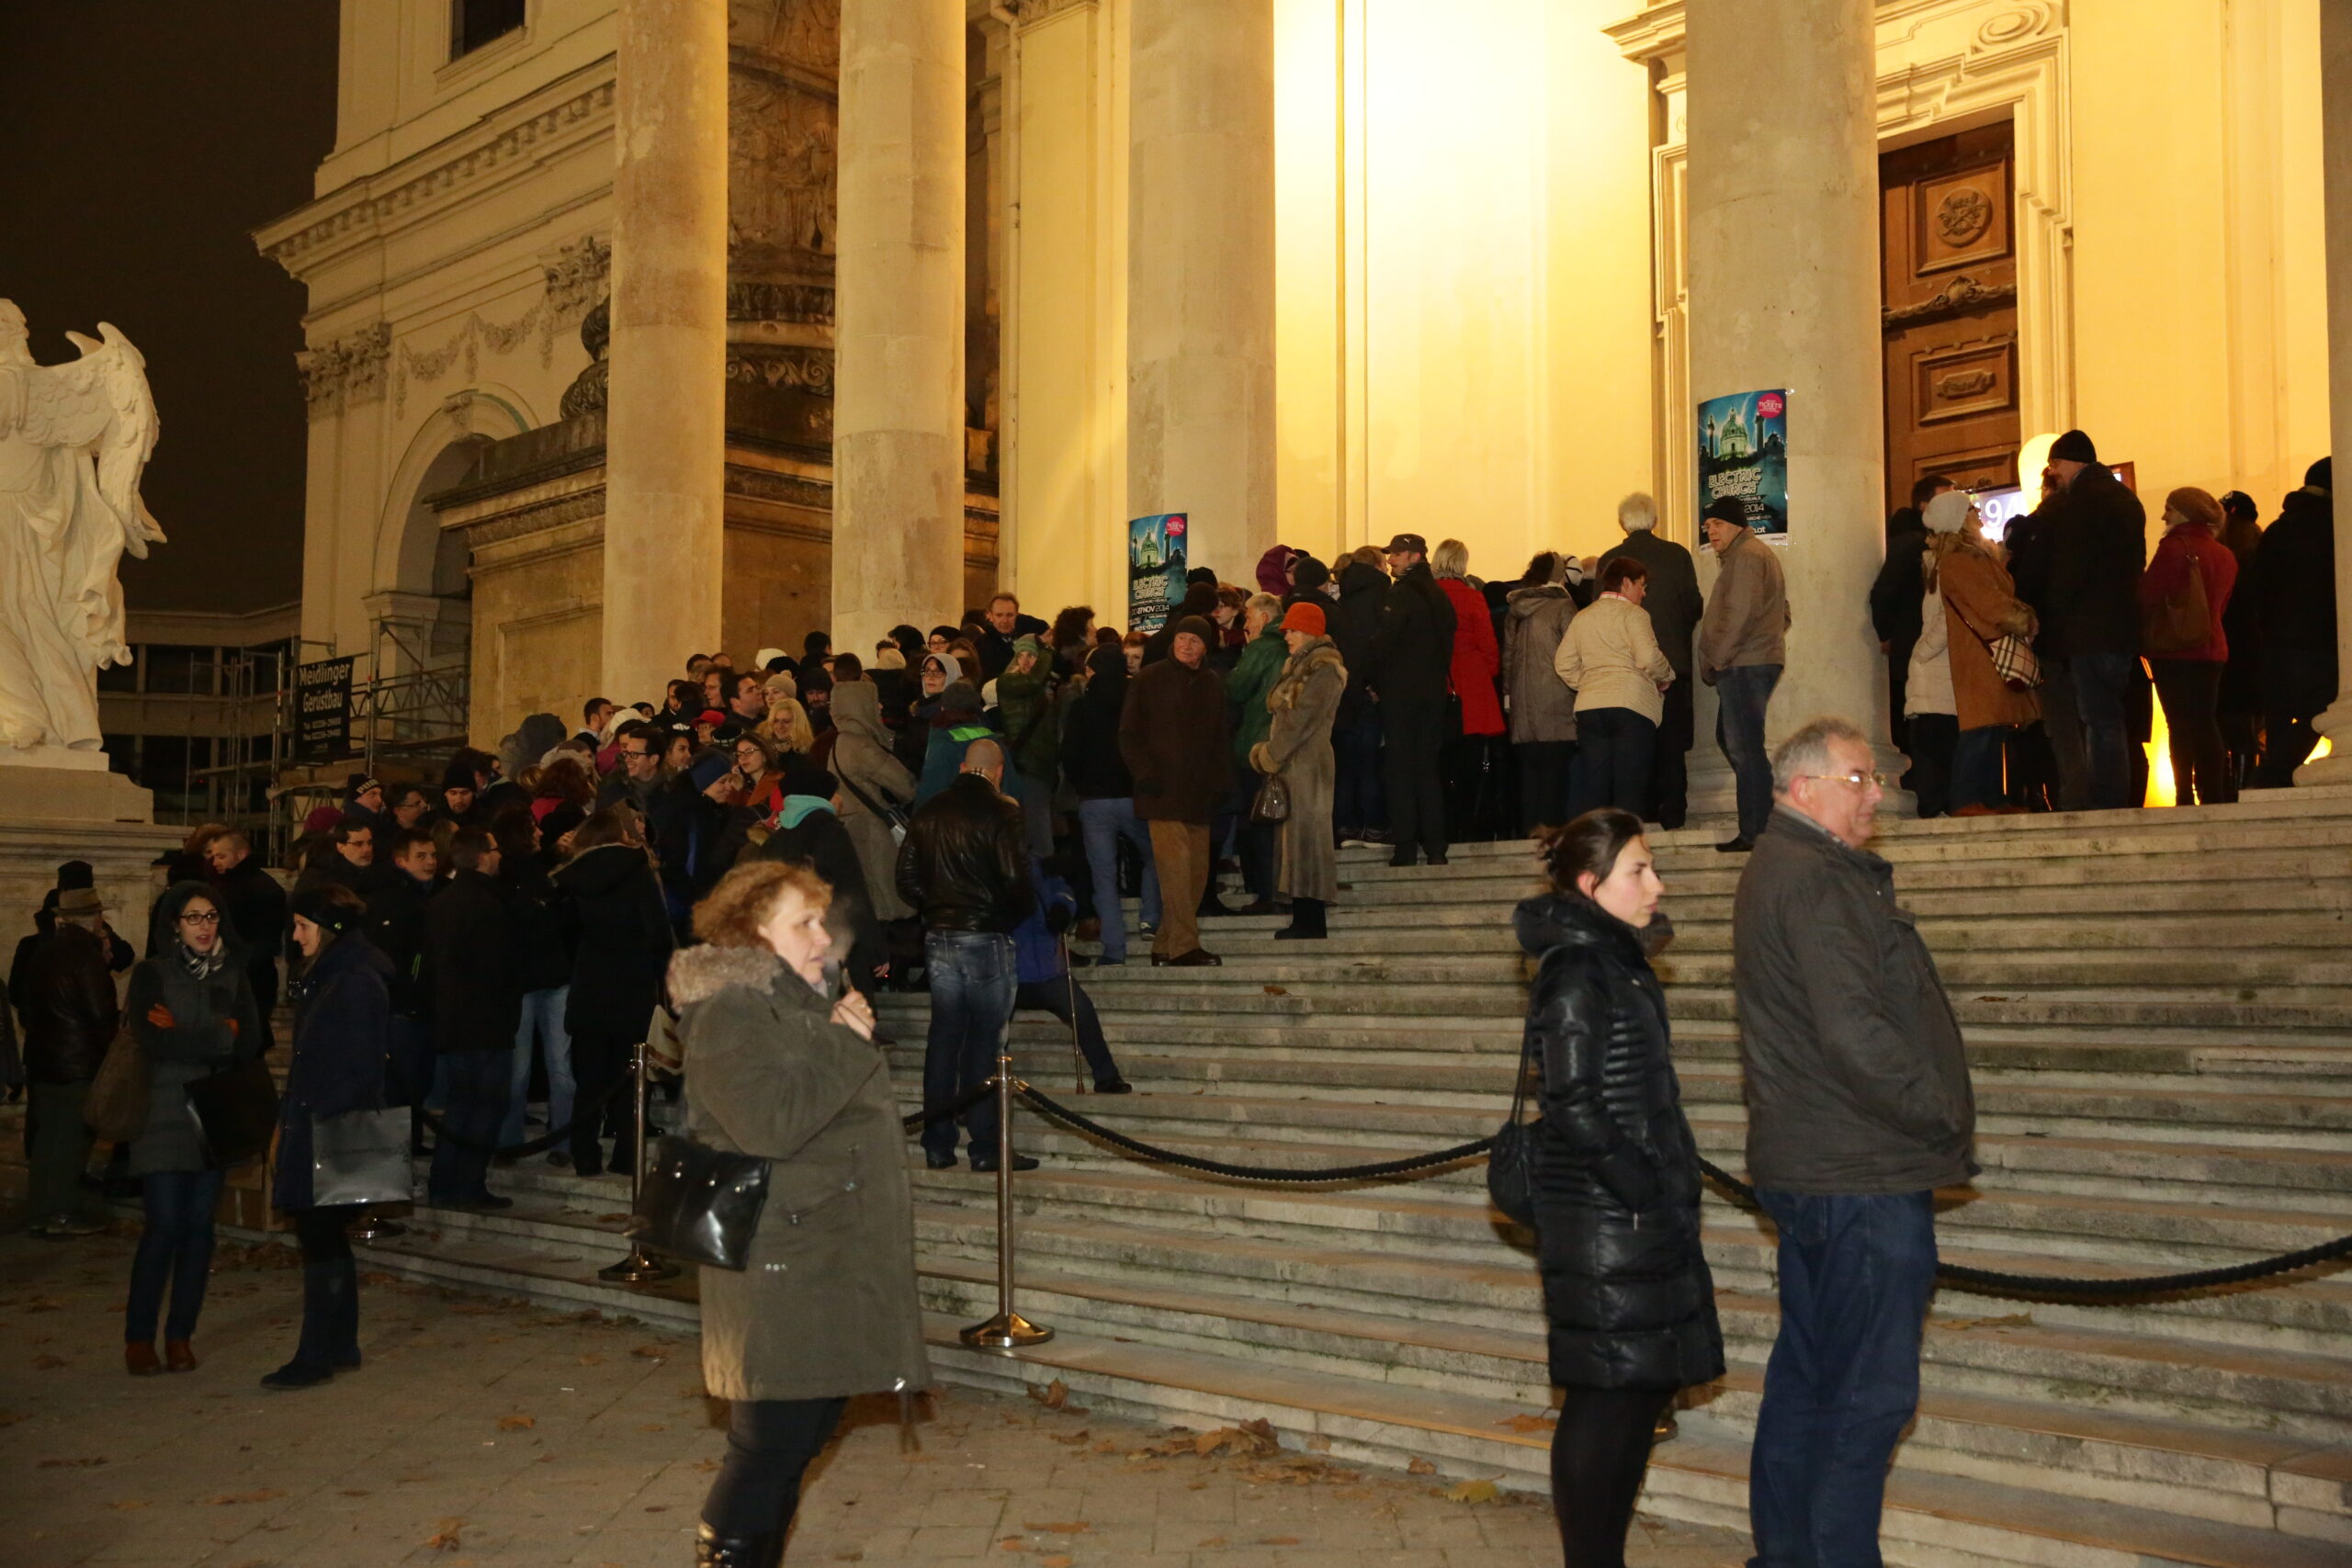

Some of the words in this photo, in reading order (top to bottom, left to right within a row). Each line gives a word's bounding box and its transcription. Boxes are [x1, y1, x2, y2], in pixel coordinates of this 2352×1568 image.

[1709, 468, 1761, 489] ELECTRIC
[1711, 481, 1758, 500] CHURCH
[1744, 503, 1765, 513] 2014
[299, 661, 350, 687] Meidlinger
[303, 688, 344, 713] Gerüstbau
